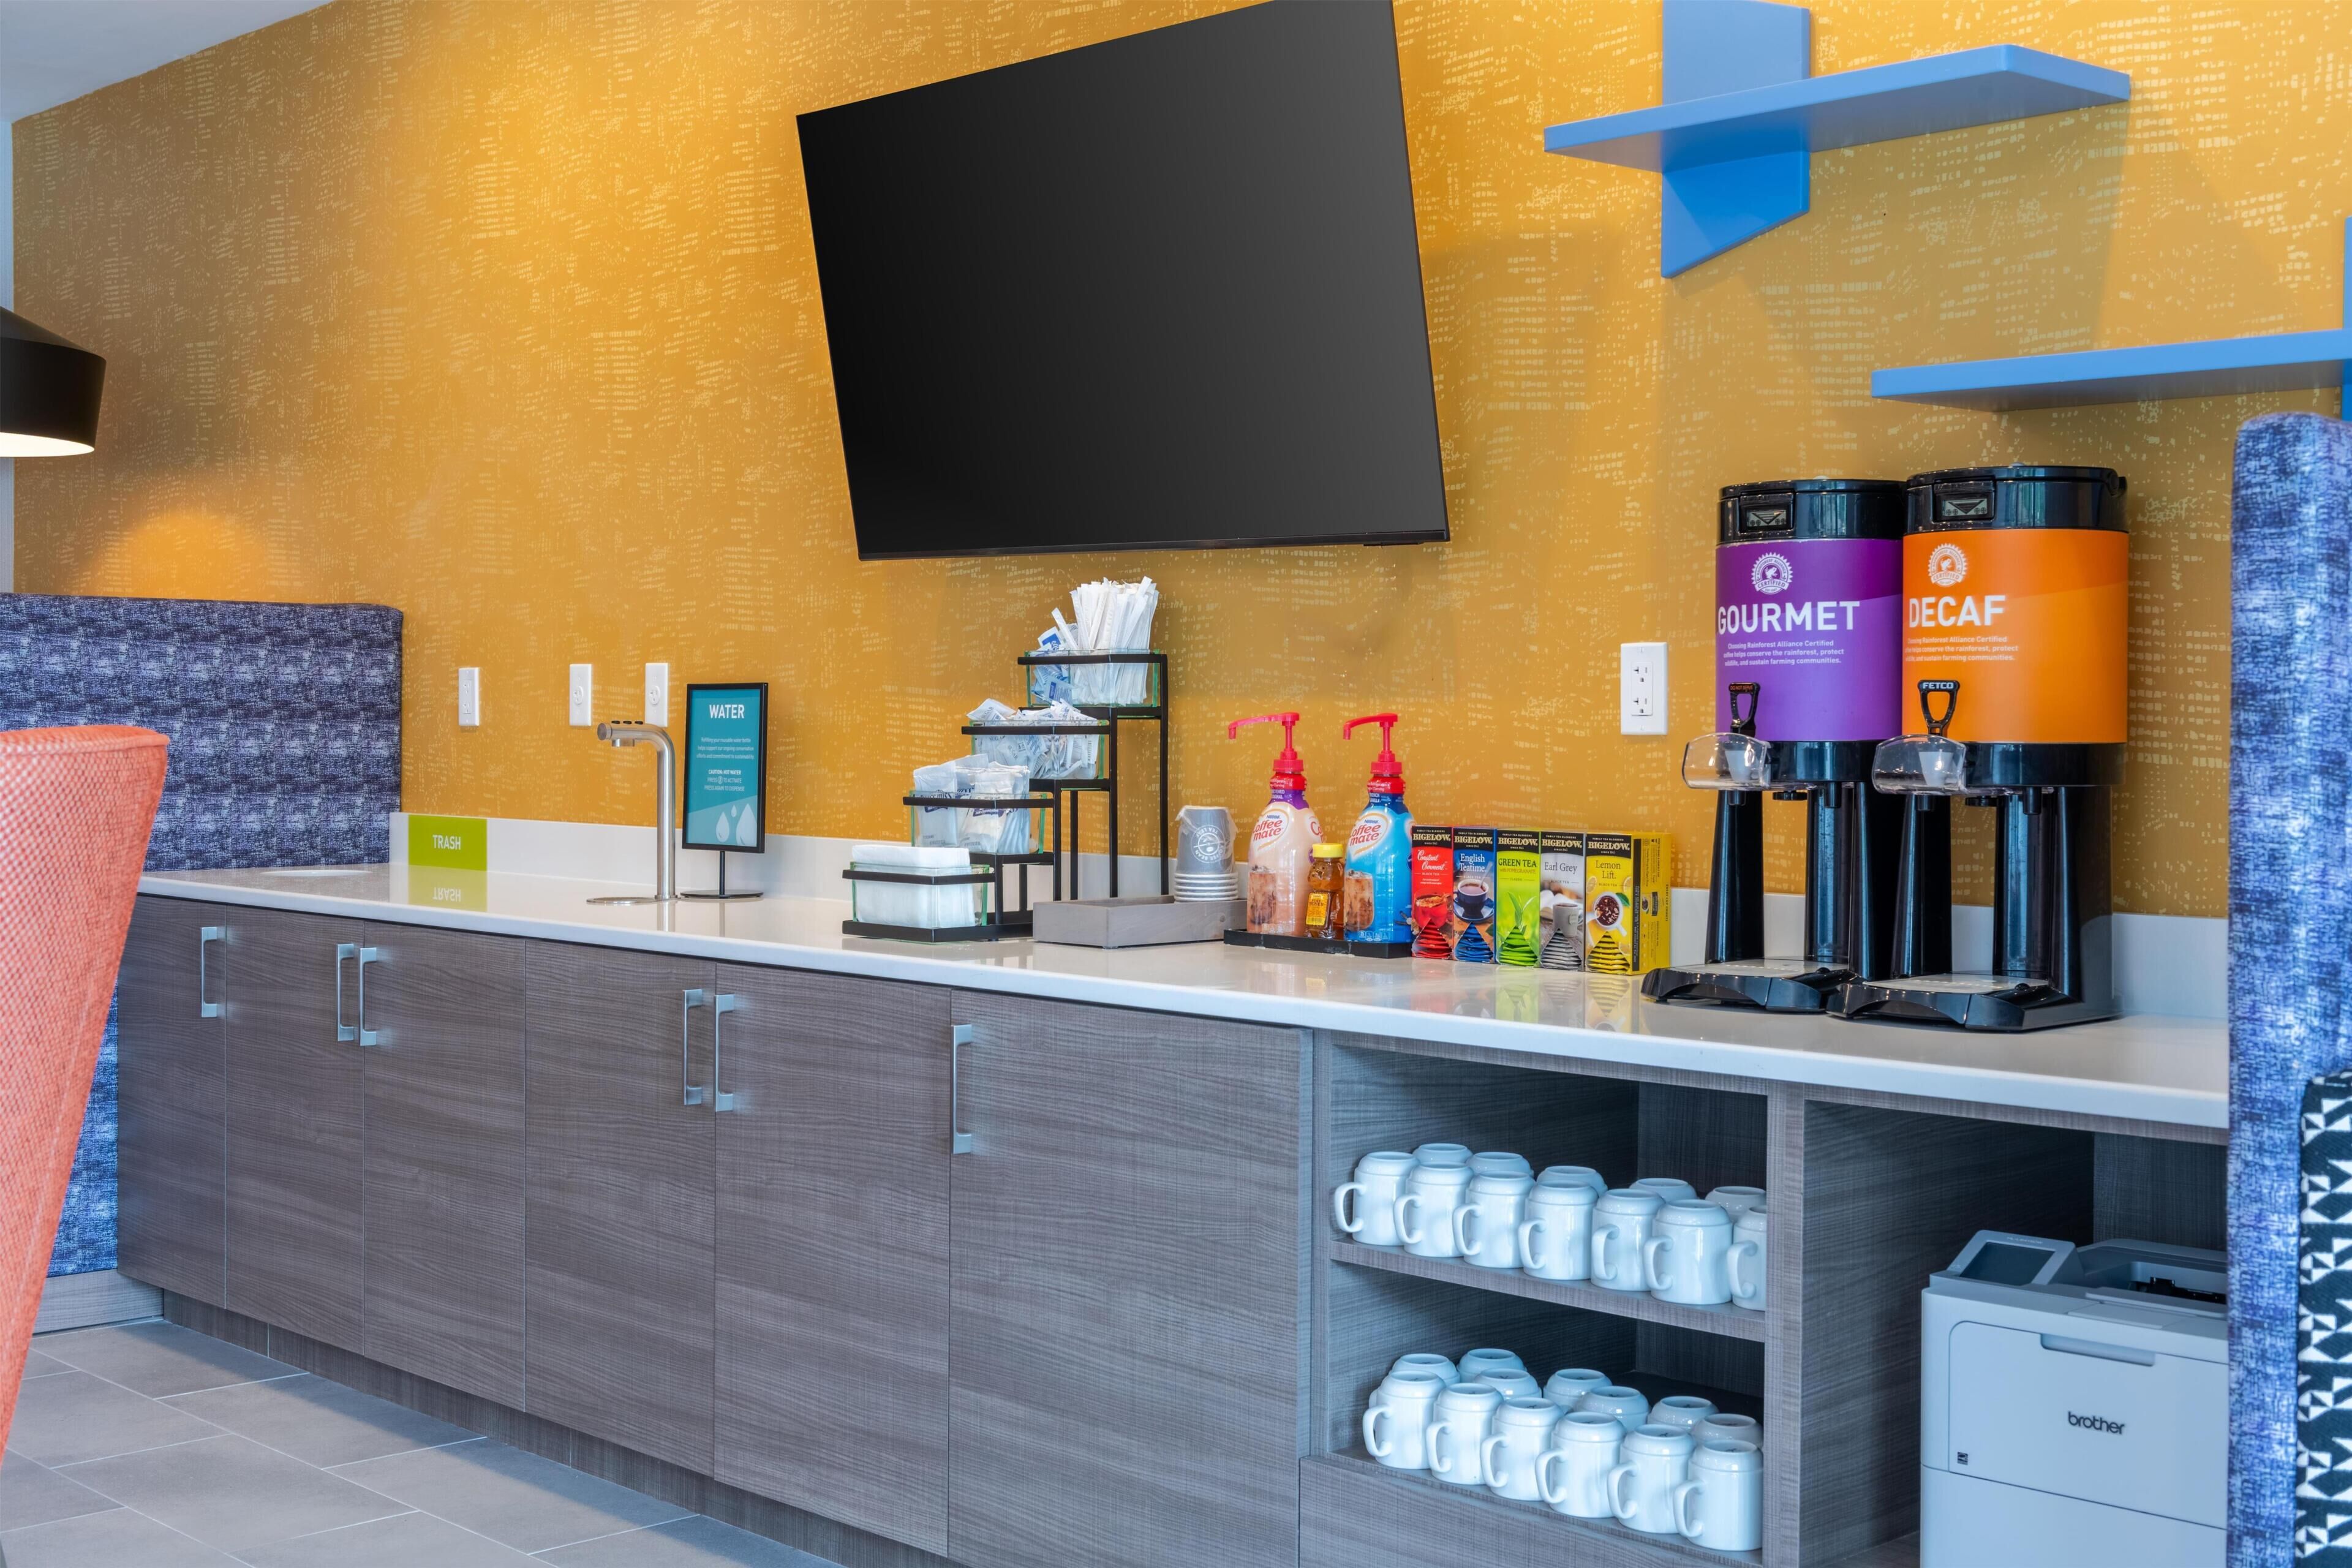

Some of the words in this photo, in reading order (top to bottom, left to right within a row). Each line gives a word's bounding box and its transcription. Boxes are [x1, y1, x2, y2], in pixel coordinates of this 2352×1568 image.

[1757, 580, 1785, 589] CERTIFIED
[1909, 595, 2006, 628] DECAF
[1718, 601, 1860, 635] GOURMET
[709, 704, 745, 719] WATER
[1254, 820, 1283, 832] offee
[1352, 824, 1381, 837] offee
[1254, 827, 1281, 842] mate
[1350, 832, 1379, 846] mate
[1413, 833, 1451, 842] BIGELOW
[432, 834, 461, 850] TRASH
[1498, 837, 1538, 846] BIGELOW
[1542, 839, 1583, 848] BIGELOW
[1587, 841, 1630, 851] BIGELOW
[1460, 853, 1485, 864] English
[1498, 858, 1521, 867] GREEN
[1523, 859, 1537, 867] TEA
[1596, 860, 1621, 869] Lemon
[1545, 862, 1558, 871] Earl
[1559, 862, 1578, 874] Grey
[2068, 1411, 2125, 1435] brother
